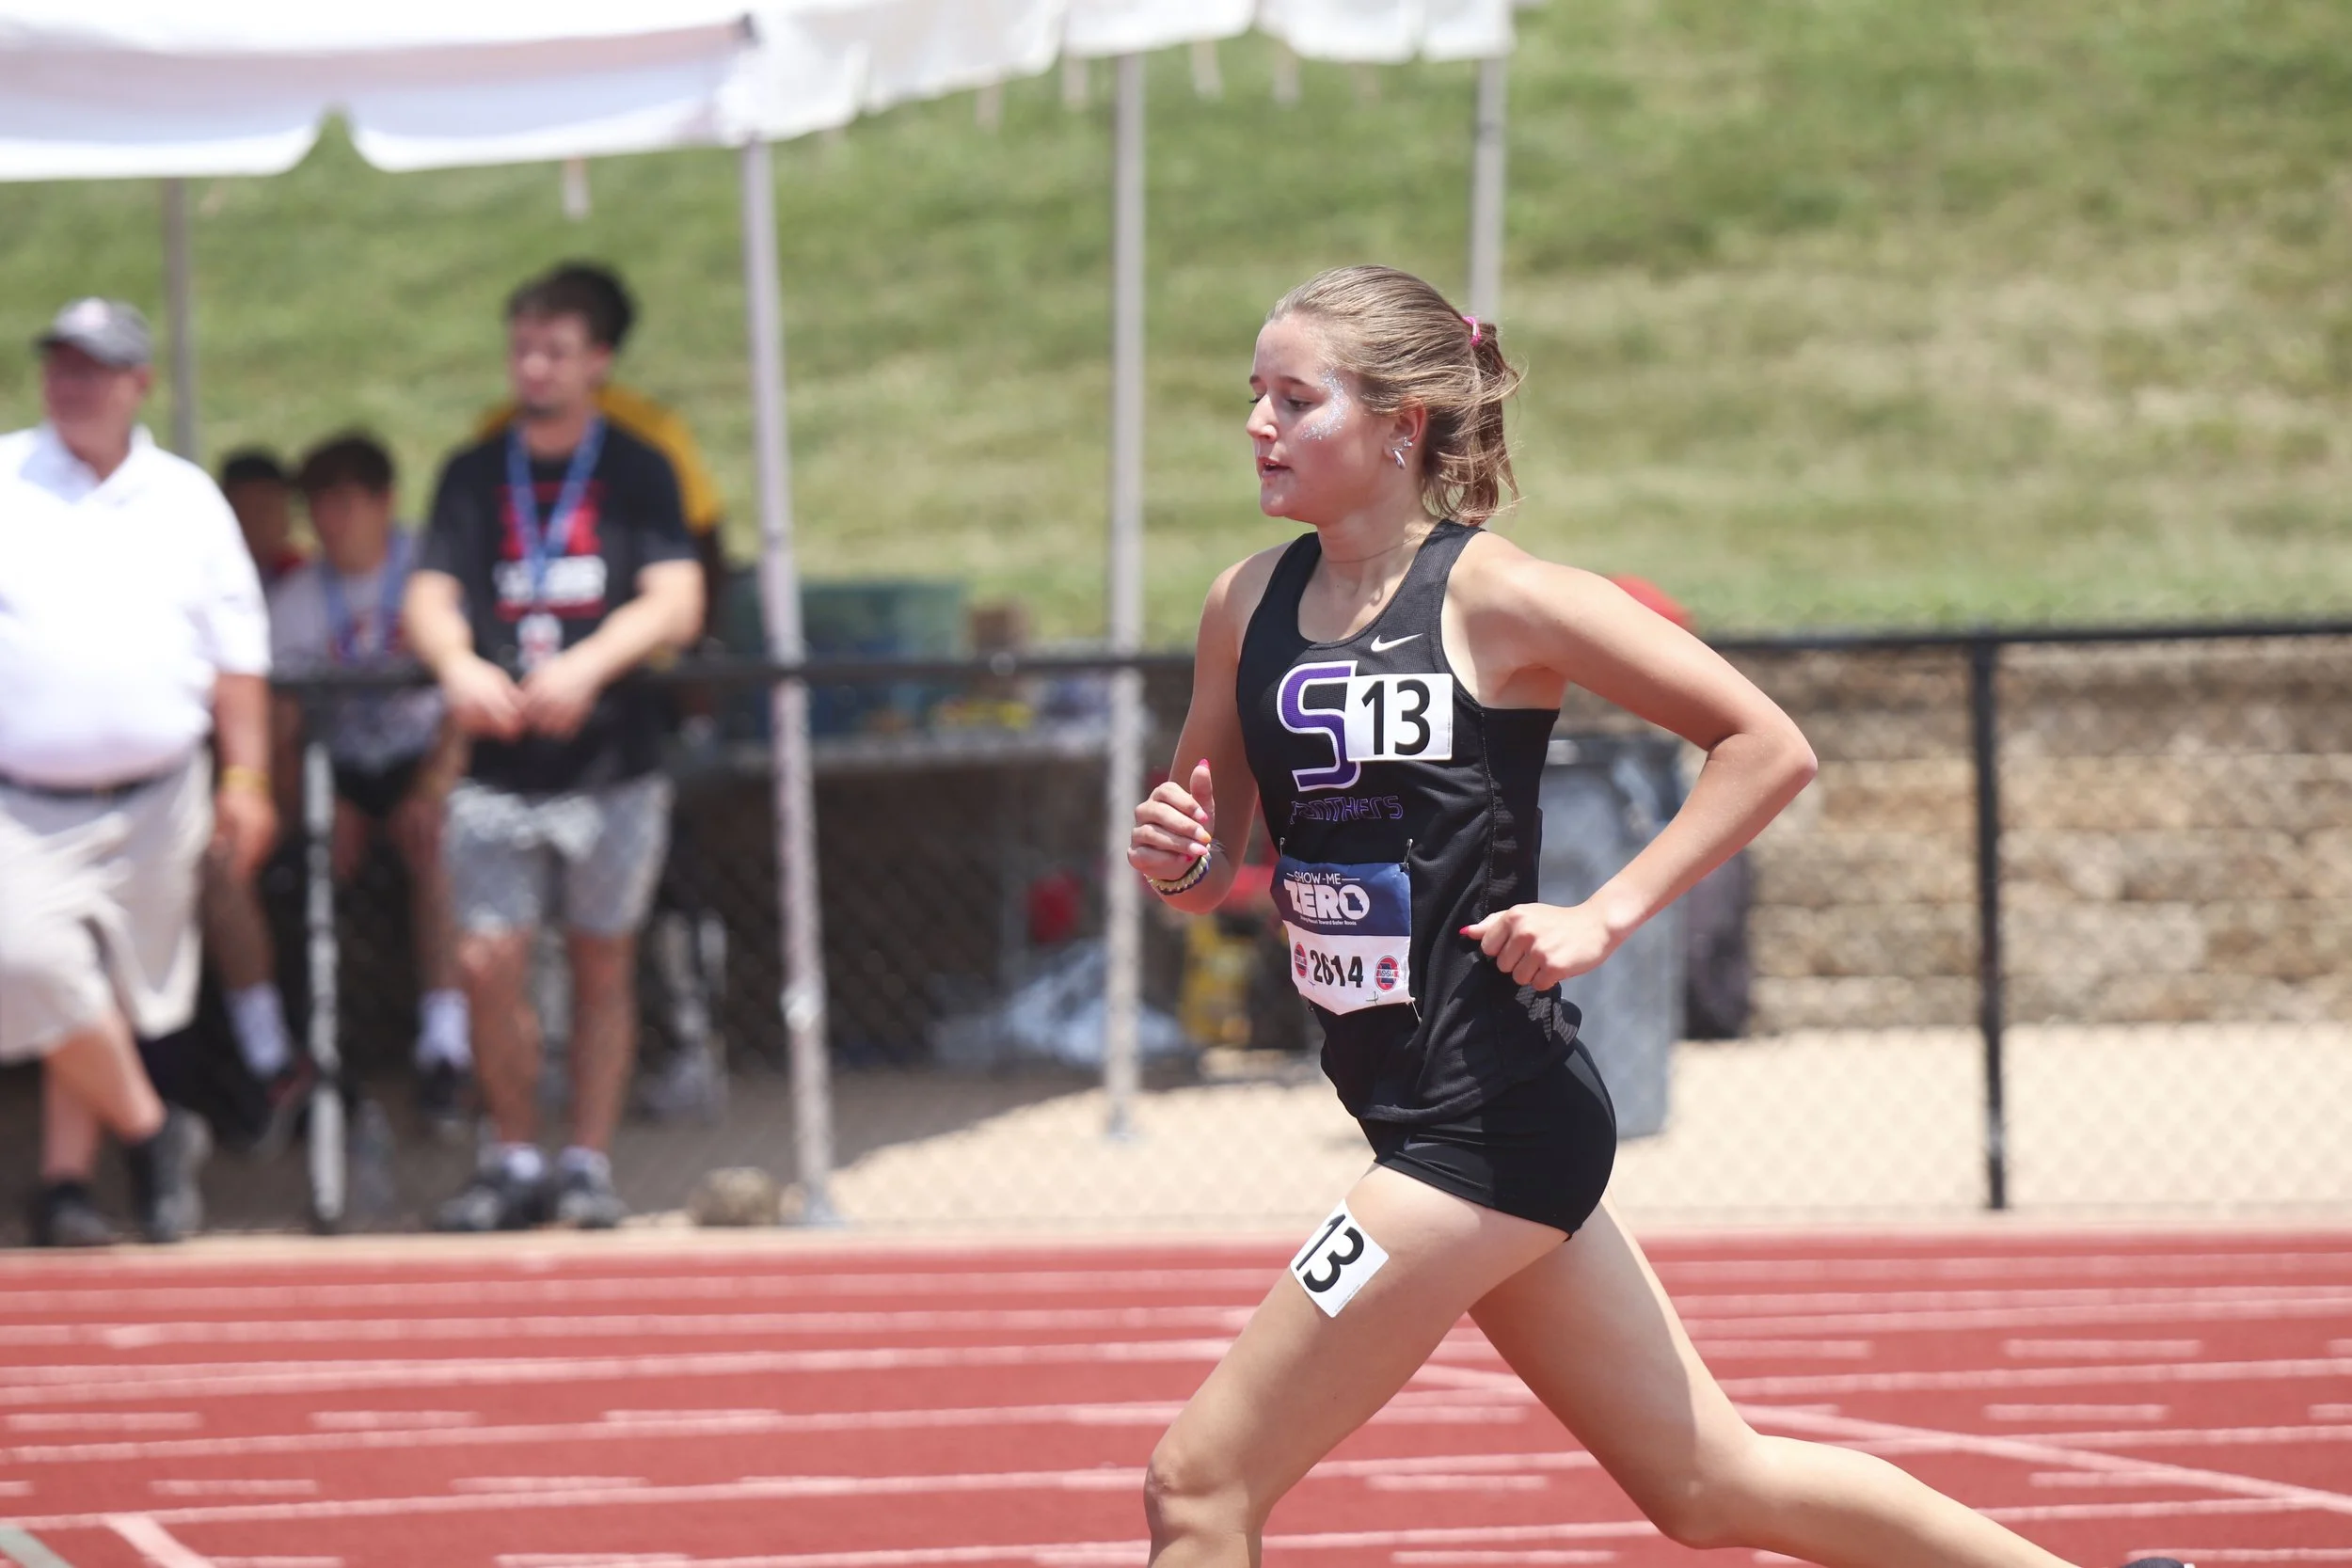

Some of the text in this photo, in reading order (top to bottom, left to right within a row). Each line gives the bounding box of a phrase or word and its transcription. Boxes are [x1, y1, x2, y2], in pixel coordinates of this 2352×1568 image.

[1277, 660, 1361, 792] S
[1361, 679, 1430, 756] 13
[1283, 879, 1370, 920] ZERO
[1294, 871, 1342, 885] SHOW-ME
[1310, 949, 1364, 989] 2614
[1295, 1212, 1365, 1293] 13
